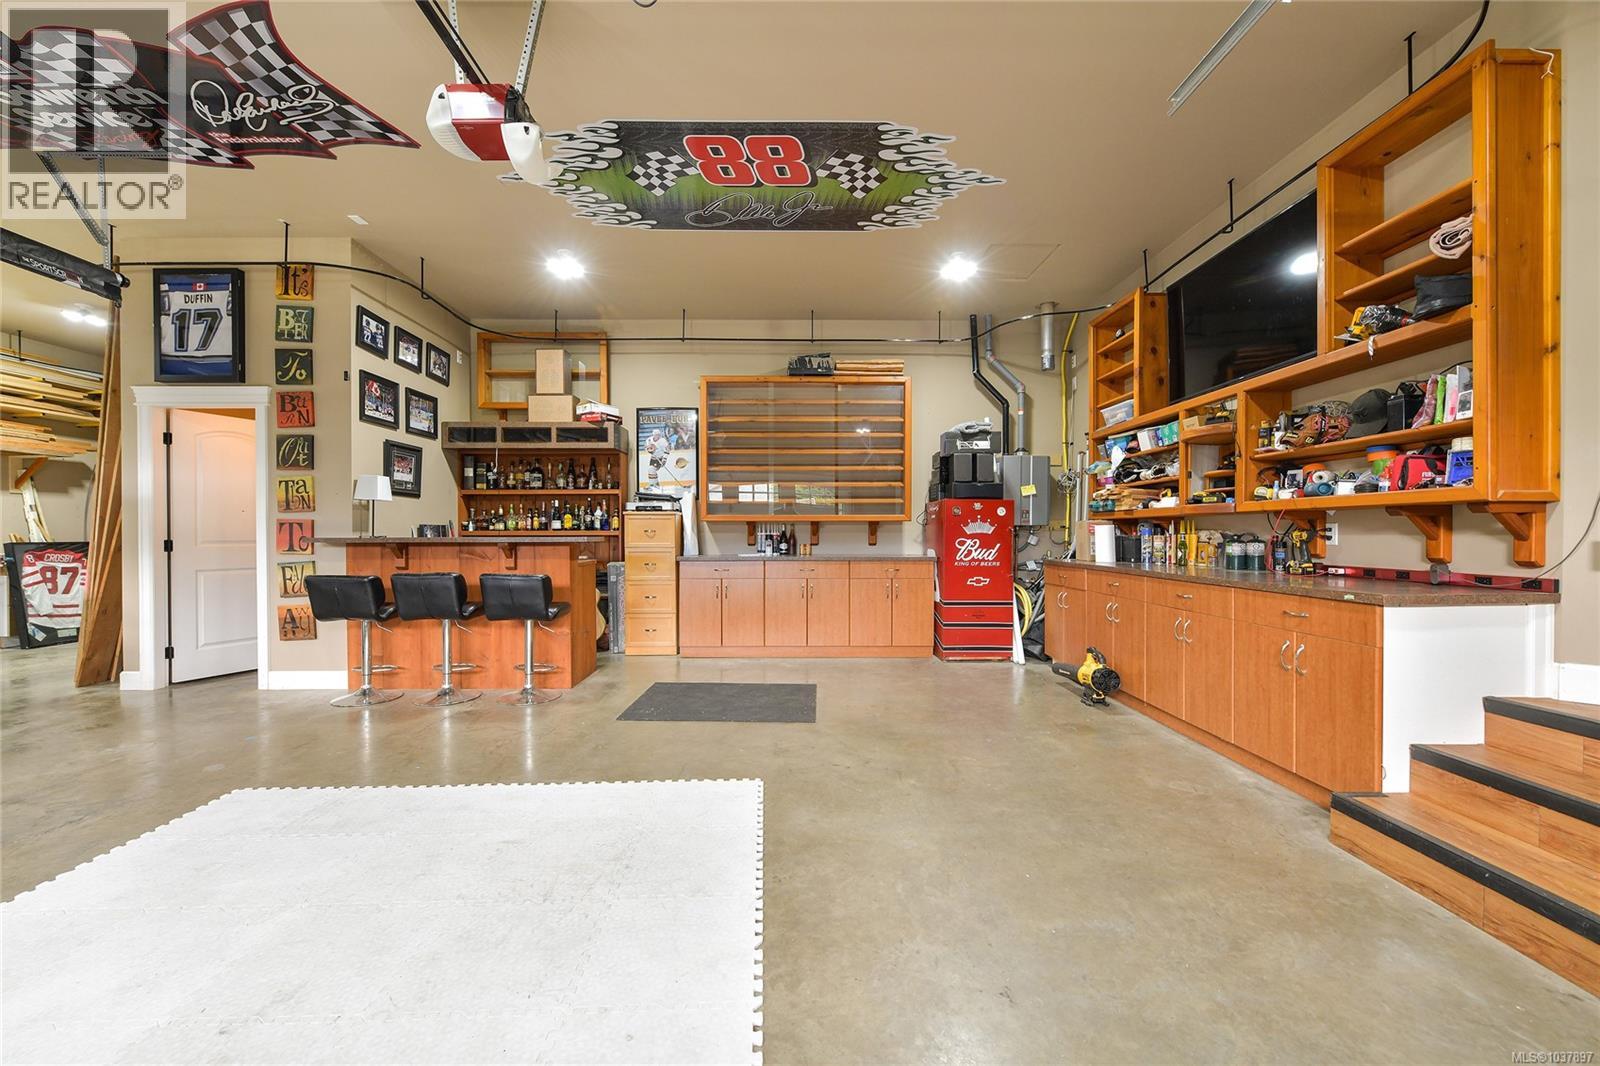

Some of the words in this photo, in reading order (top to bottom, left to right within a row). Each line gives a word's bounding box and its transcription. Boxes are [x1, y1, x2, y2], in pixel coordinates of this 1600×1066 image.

[683, 135, 811, 186] 88
[279, 264, 309, 298] It's
[184, 294, 213, 304] DUFFIN
[171, 308, 224, 352] 17
[277, 351, 308, 381] To
[44, 553, 73, 563] CROSBY
[955, 537, 1001, 560] Bud
